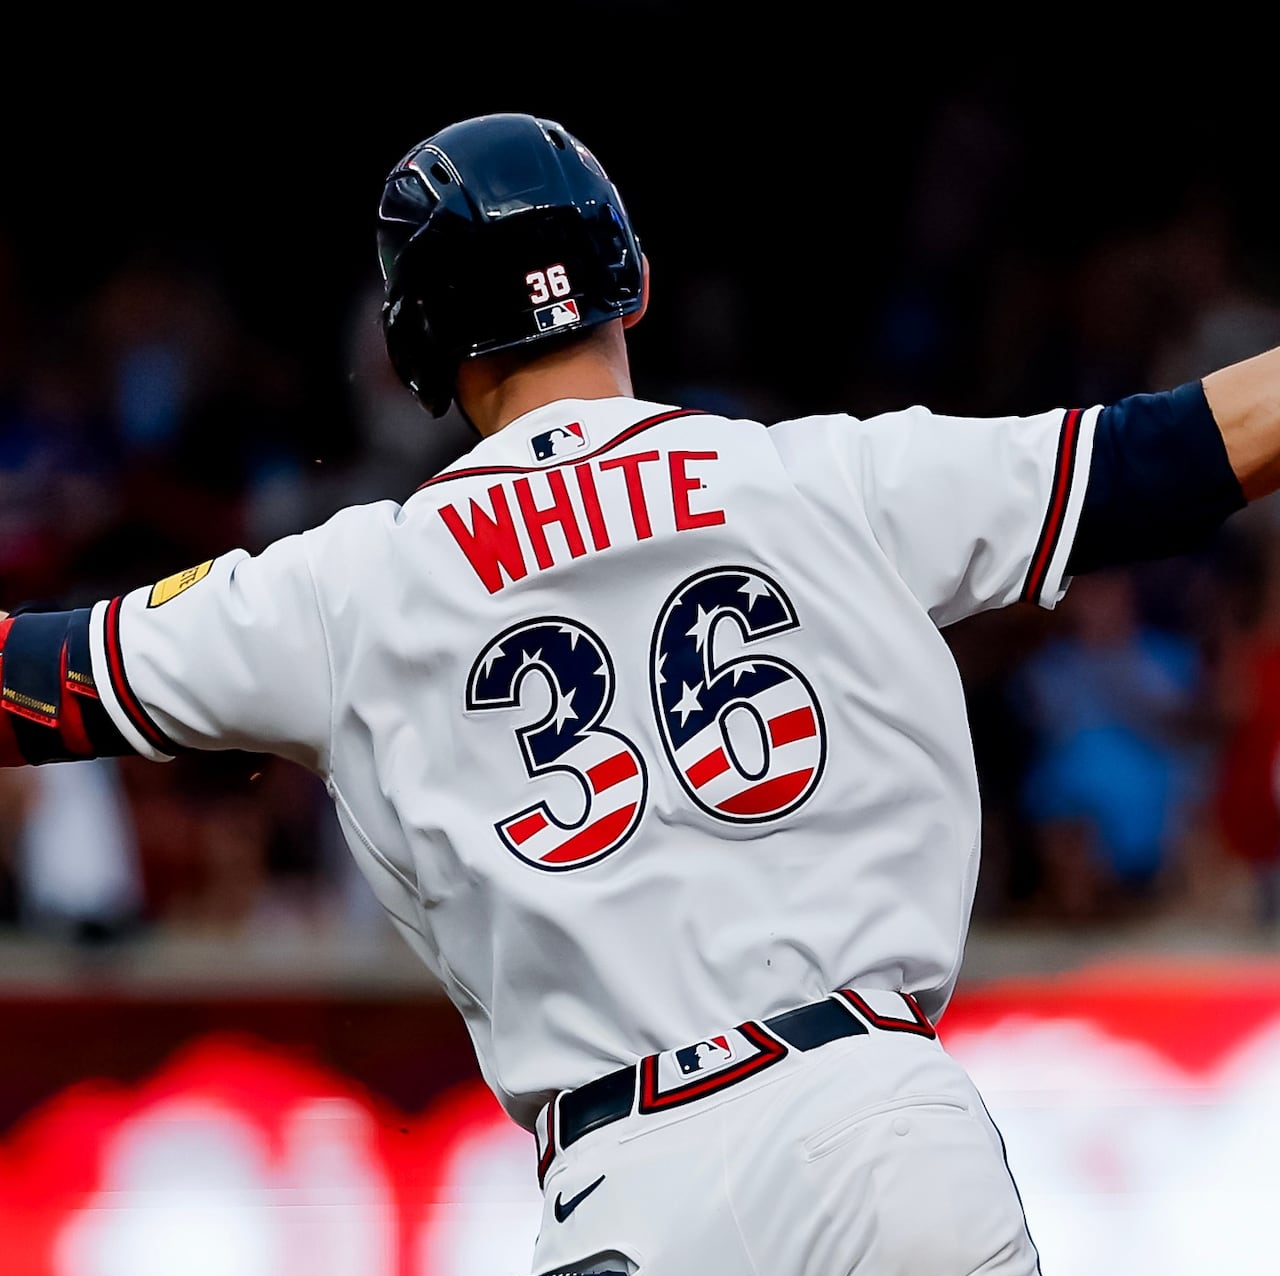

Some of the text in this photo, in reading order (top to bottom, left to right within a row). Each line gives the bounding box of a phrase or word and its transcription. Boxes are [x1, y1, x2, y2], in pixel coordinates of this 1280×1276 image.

[525, 264, 571, 304] 36
[438, 450, 726, 594] WHITE
[463, 565, 827, 872] 36
